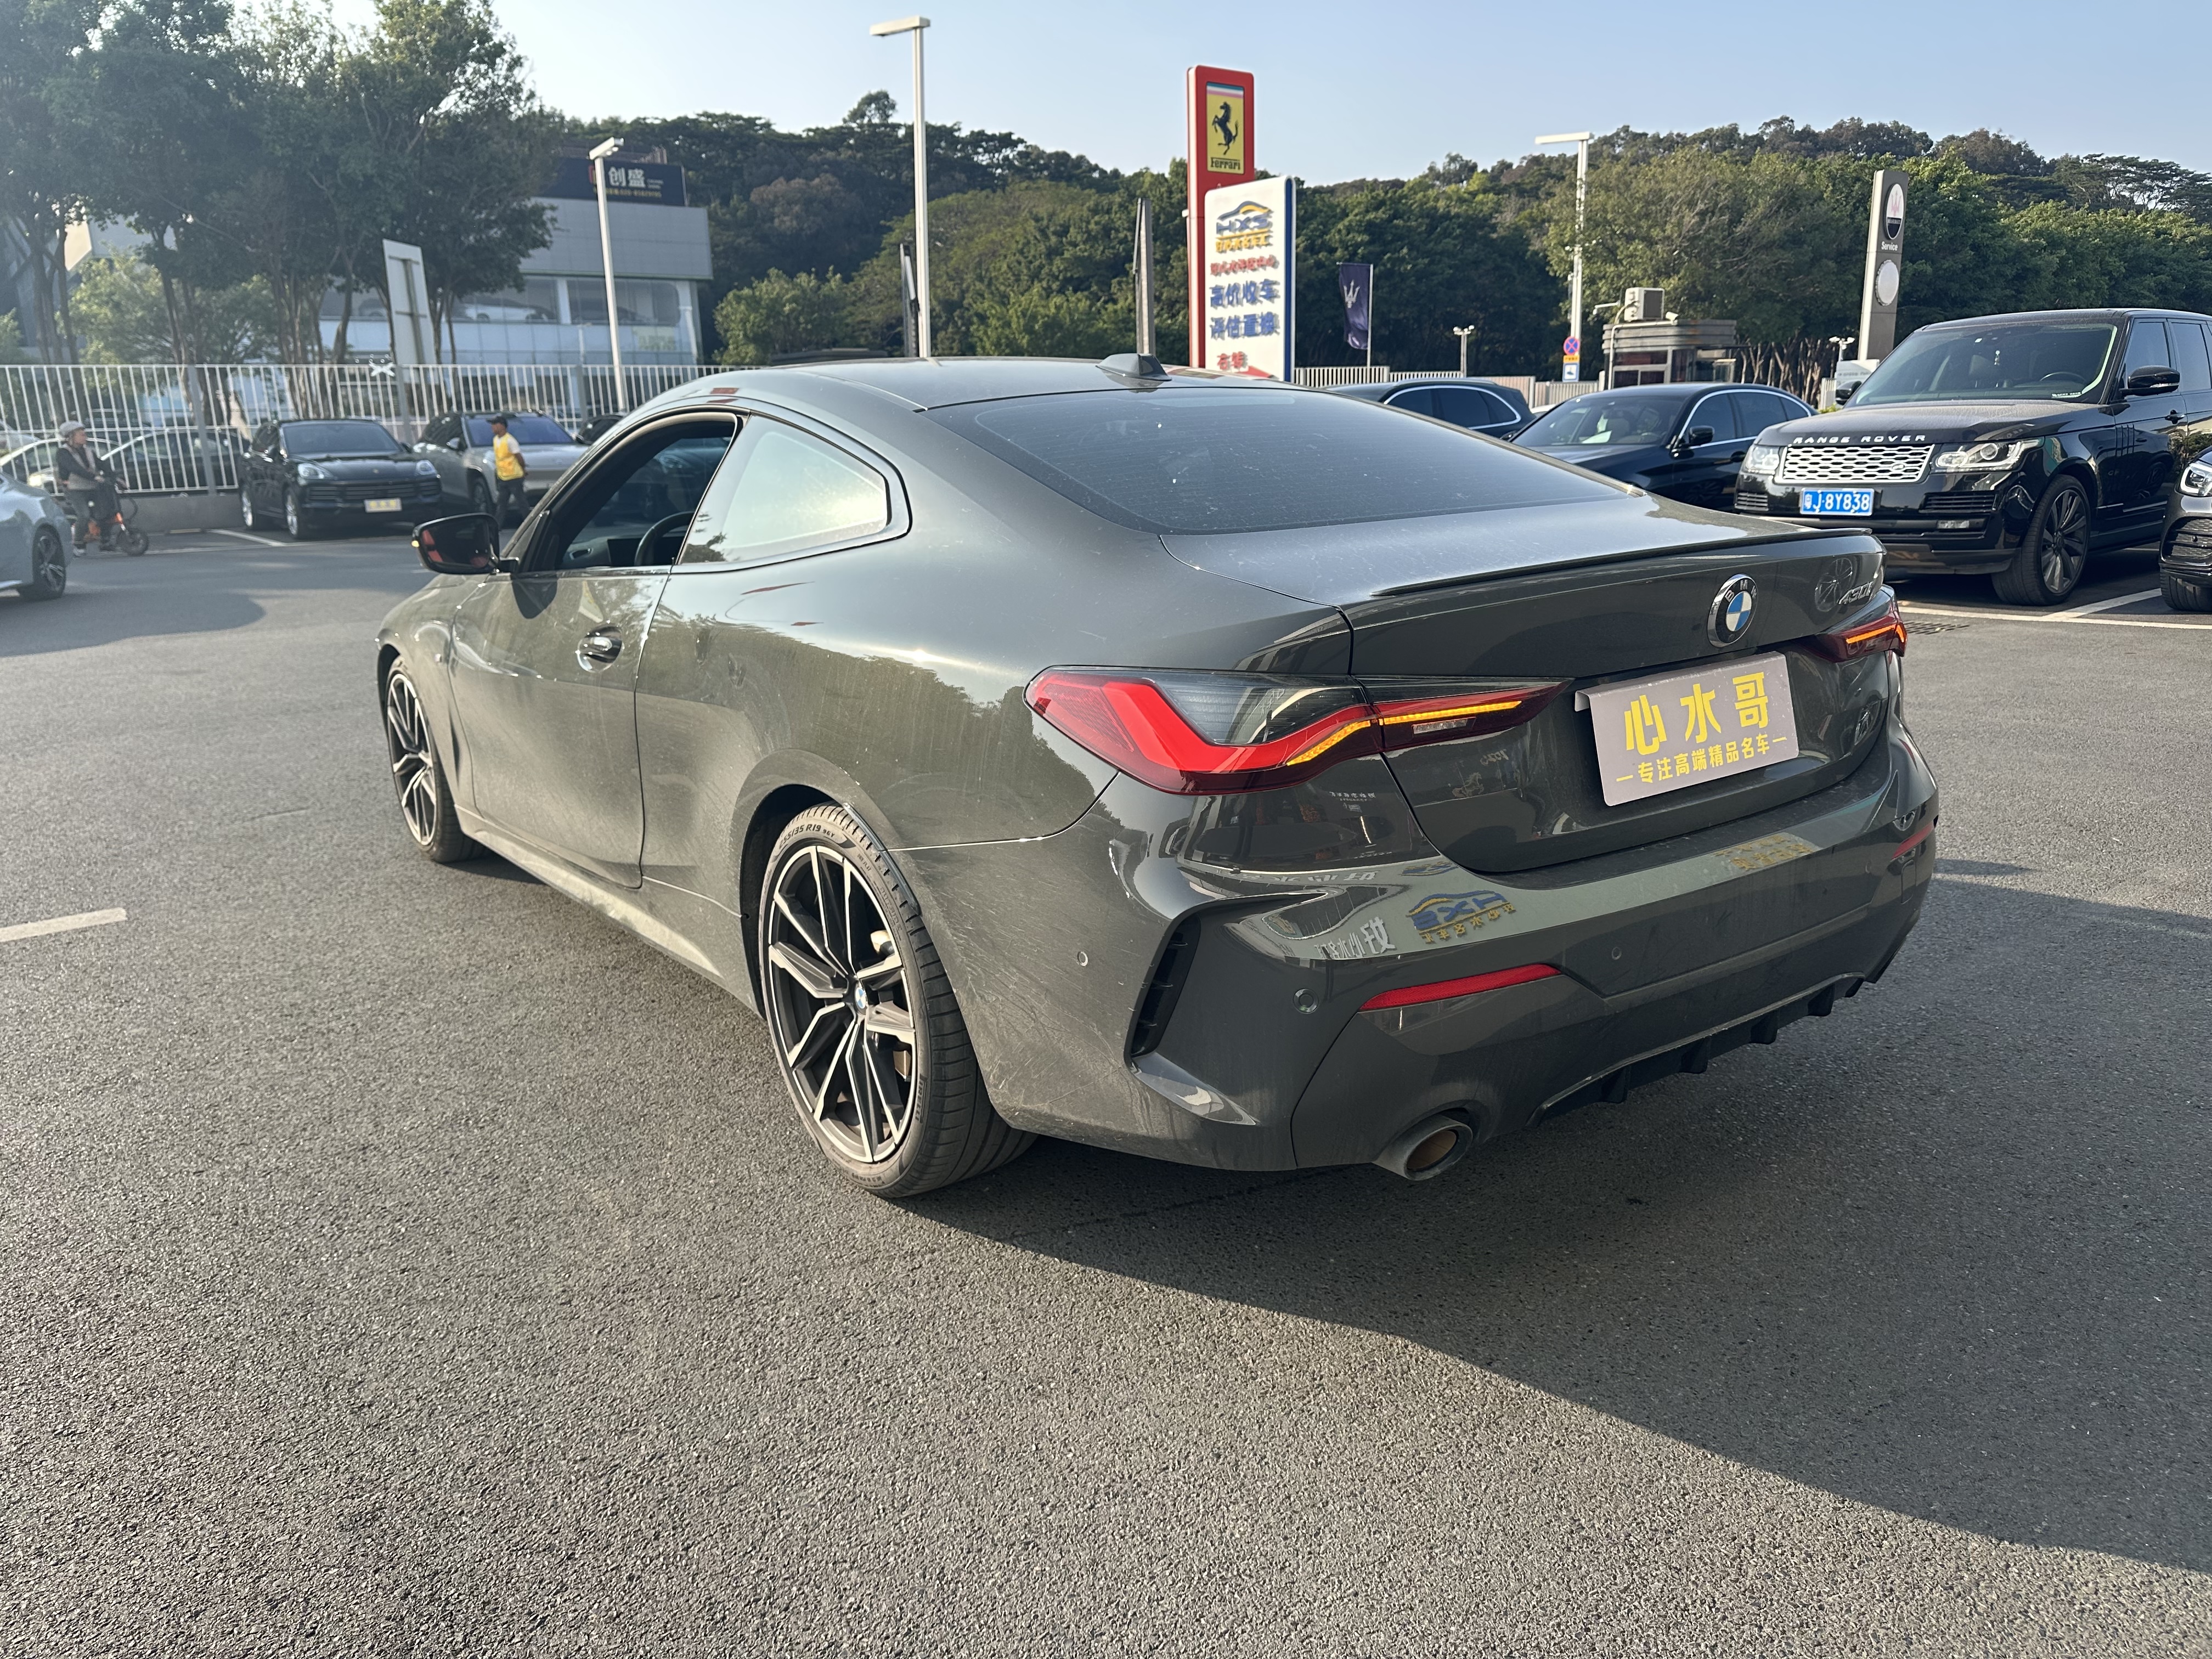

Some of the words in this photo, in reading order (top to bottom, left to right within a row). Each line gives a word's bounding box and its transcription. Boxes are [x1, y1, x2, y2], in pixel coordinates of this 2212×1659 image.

[1211, 157, 1241, 170] Ferrari
[608, 166, 646, 188] 创盛
[1881, 241, 1898, 251] Service
[1210, 279, 1277, 307] 高价收车
[1210, 312, 1276, 339] 评估置换
[1838, 581, 1874, 604] 430i
[1624, 672, 1769, 755] 心水哥
[779, 824, 805, 849] 255/35
[805, 824, 822, 832] R19
[915, 1073, 928, 1123] PIRELLI
